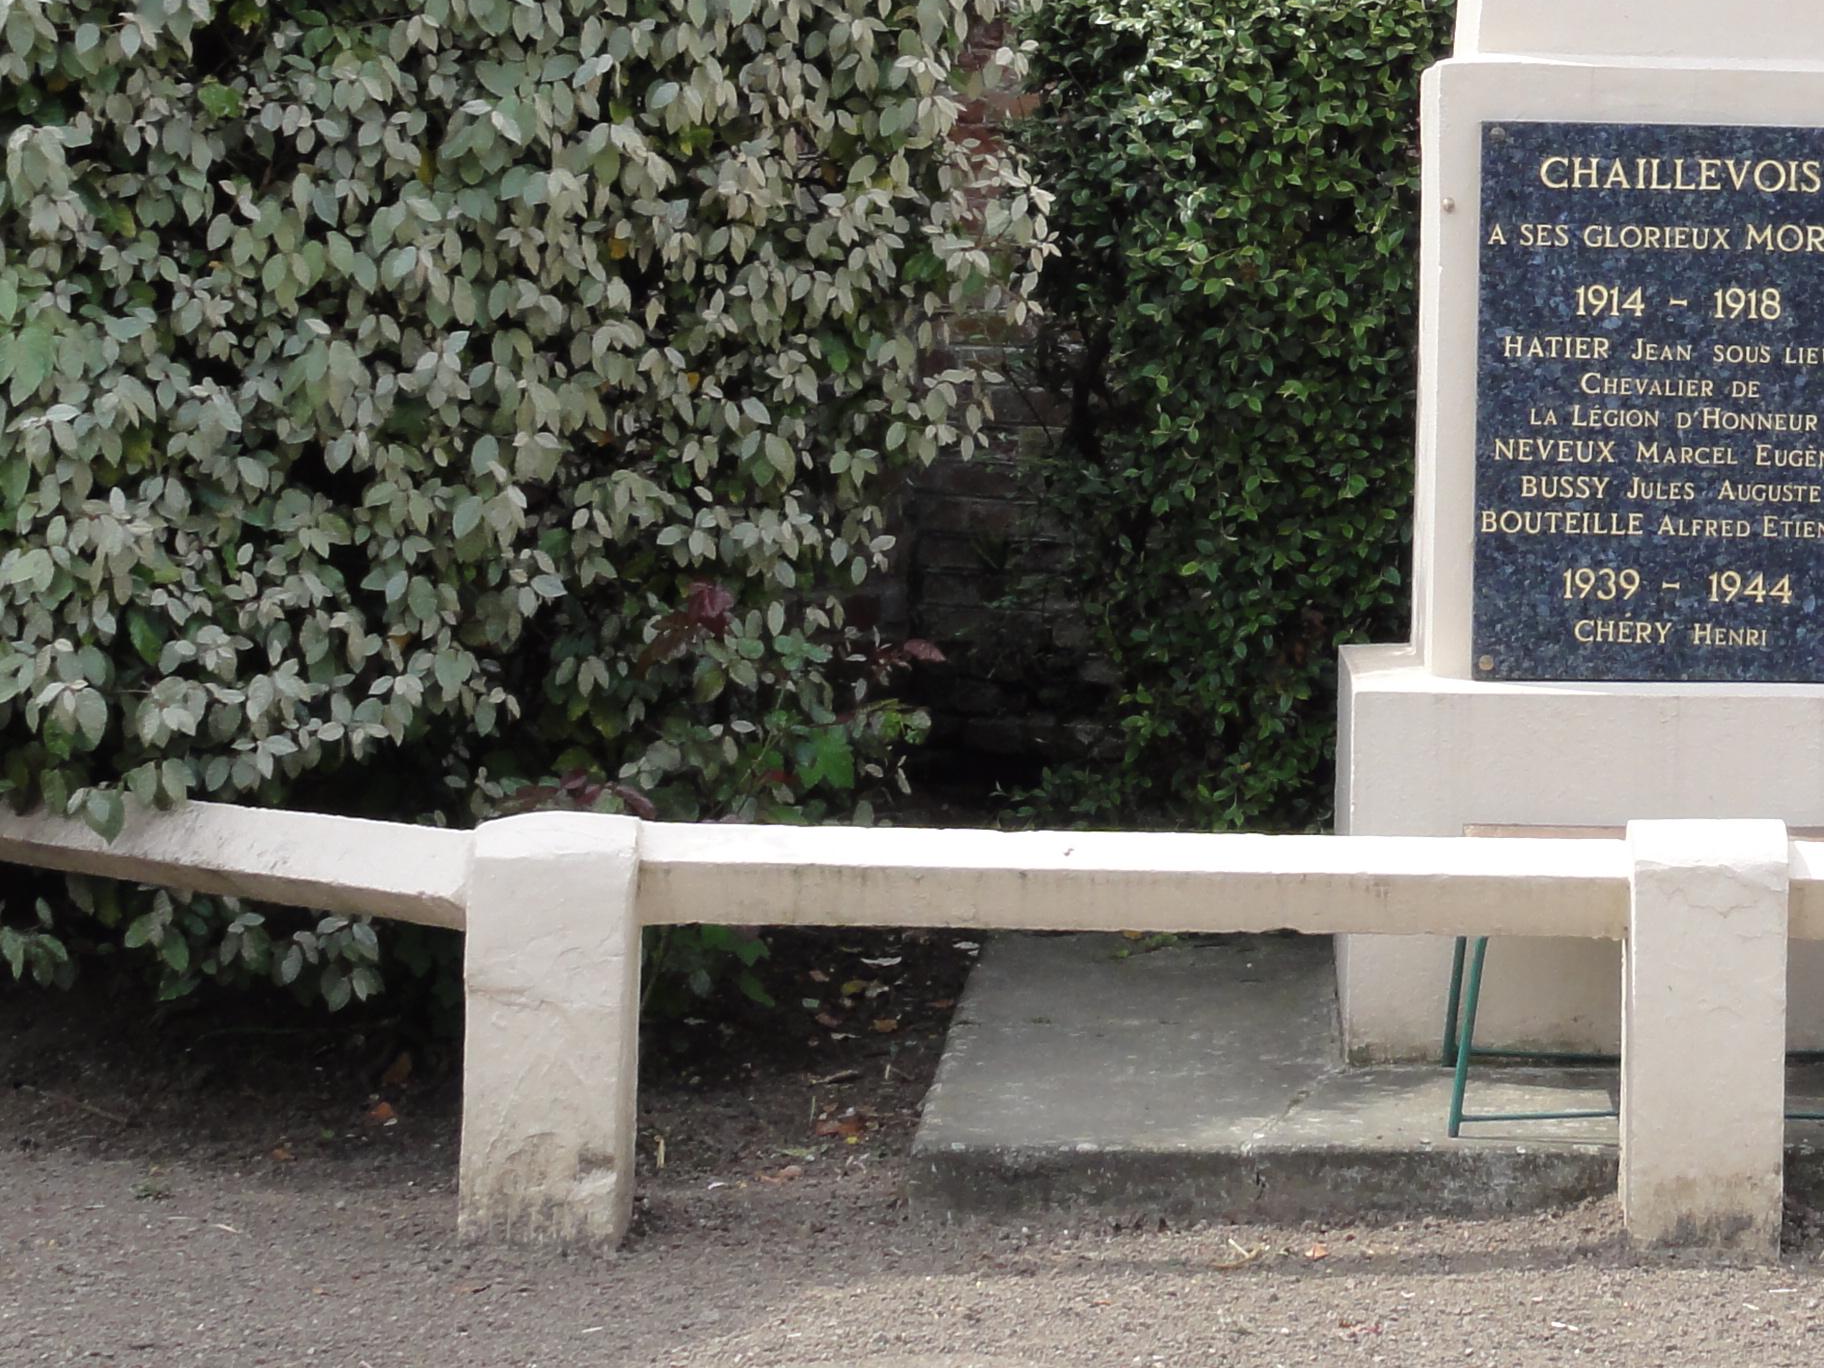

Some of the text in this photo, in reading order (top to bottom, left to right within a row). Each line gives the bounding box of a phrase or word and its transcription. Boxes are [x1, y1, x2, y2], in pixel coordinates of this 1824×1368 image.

[1540, 157, 1822, 194] CHAILLEVOIS
[1488, 225, 1507, 246] A
[1519, 225, 1569, 247] SES
[1584, 226, 1730, 250] GLORIEUX
[1575, 285, 1646, 317] 1914
[1714, 288, 1782, 321] 1918
[1504, 336, 1610, 360] HATIER
[1713, 345, 1771, 364] SOUS
[1581, 372, 1760, 398] CHEVALIER DE
[1530, 409, 1556, 426] LA
[1494, 439, 1615, 464] NEVEUX
[1636, 442, 1738, 465] MARCEL
[1521, 476, 1821, 503] BUSSY JULES AUGUSTE
[1481, 511, 1643, 535] BOUTEILLE
[1658, 515, 1750, 537] ALFRED
[1563, 568, 1640, 601] 1939
[1708, 570, 1793, 604] 1944
[1693, 623, 1767, 647] HENRI
